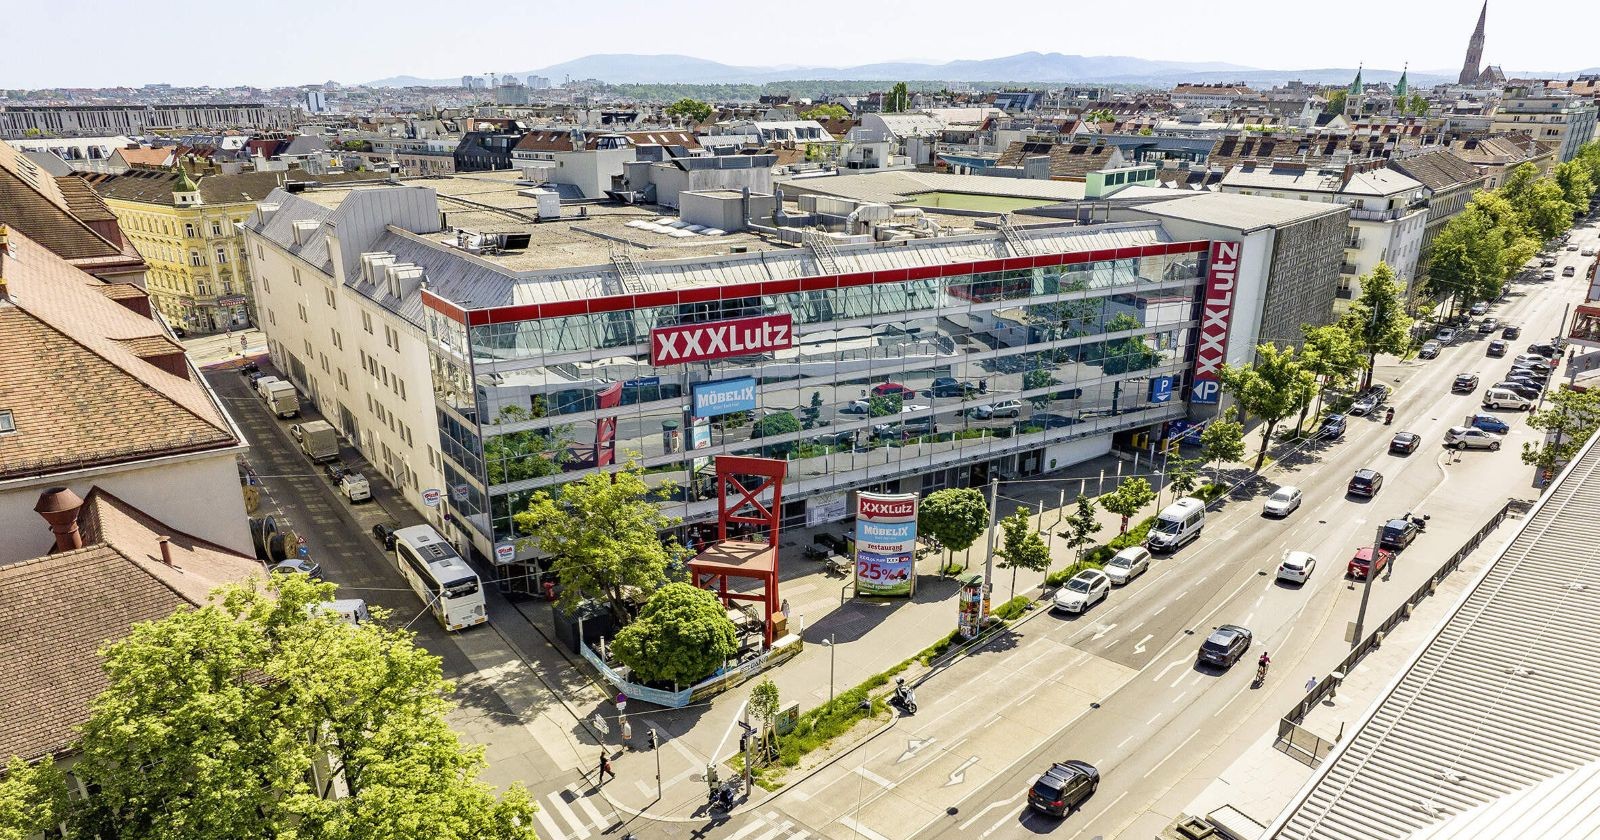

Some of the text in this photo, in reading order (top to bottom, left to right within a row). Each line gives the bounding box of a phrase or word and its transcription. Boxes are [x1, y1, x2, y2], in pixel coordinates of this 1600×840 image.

[1196, 242, 1239, 376] XXXLutz
[657, 321, 789, 361] XXXLutz
[1161, 379, 1168, 392] P
[1203, 381, 1219, 400] P
[697, 386, 754, 409] MÖBELIX
[862, 501, 912, 514] XXXLutz
[864, 524, 909, 537] MÖBELIX
[867, 543, 903, 552] restaurant
